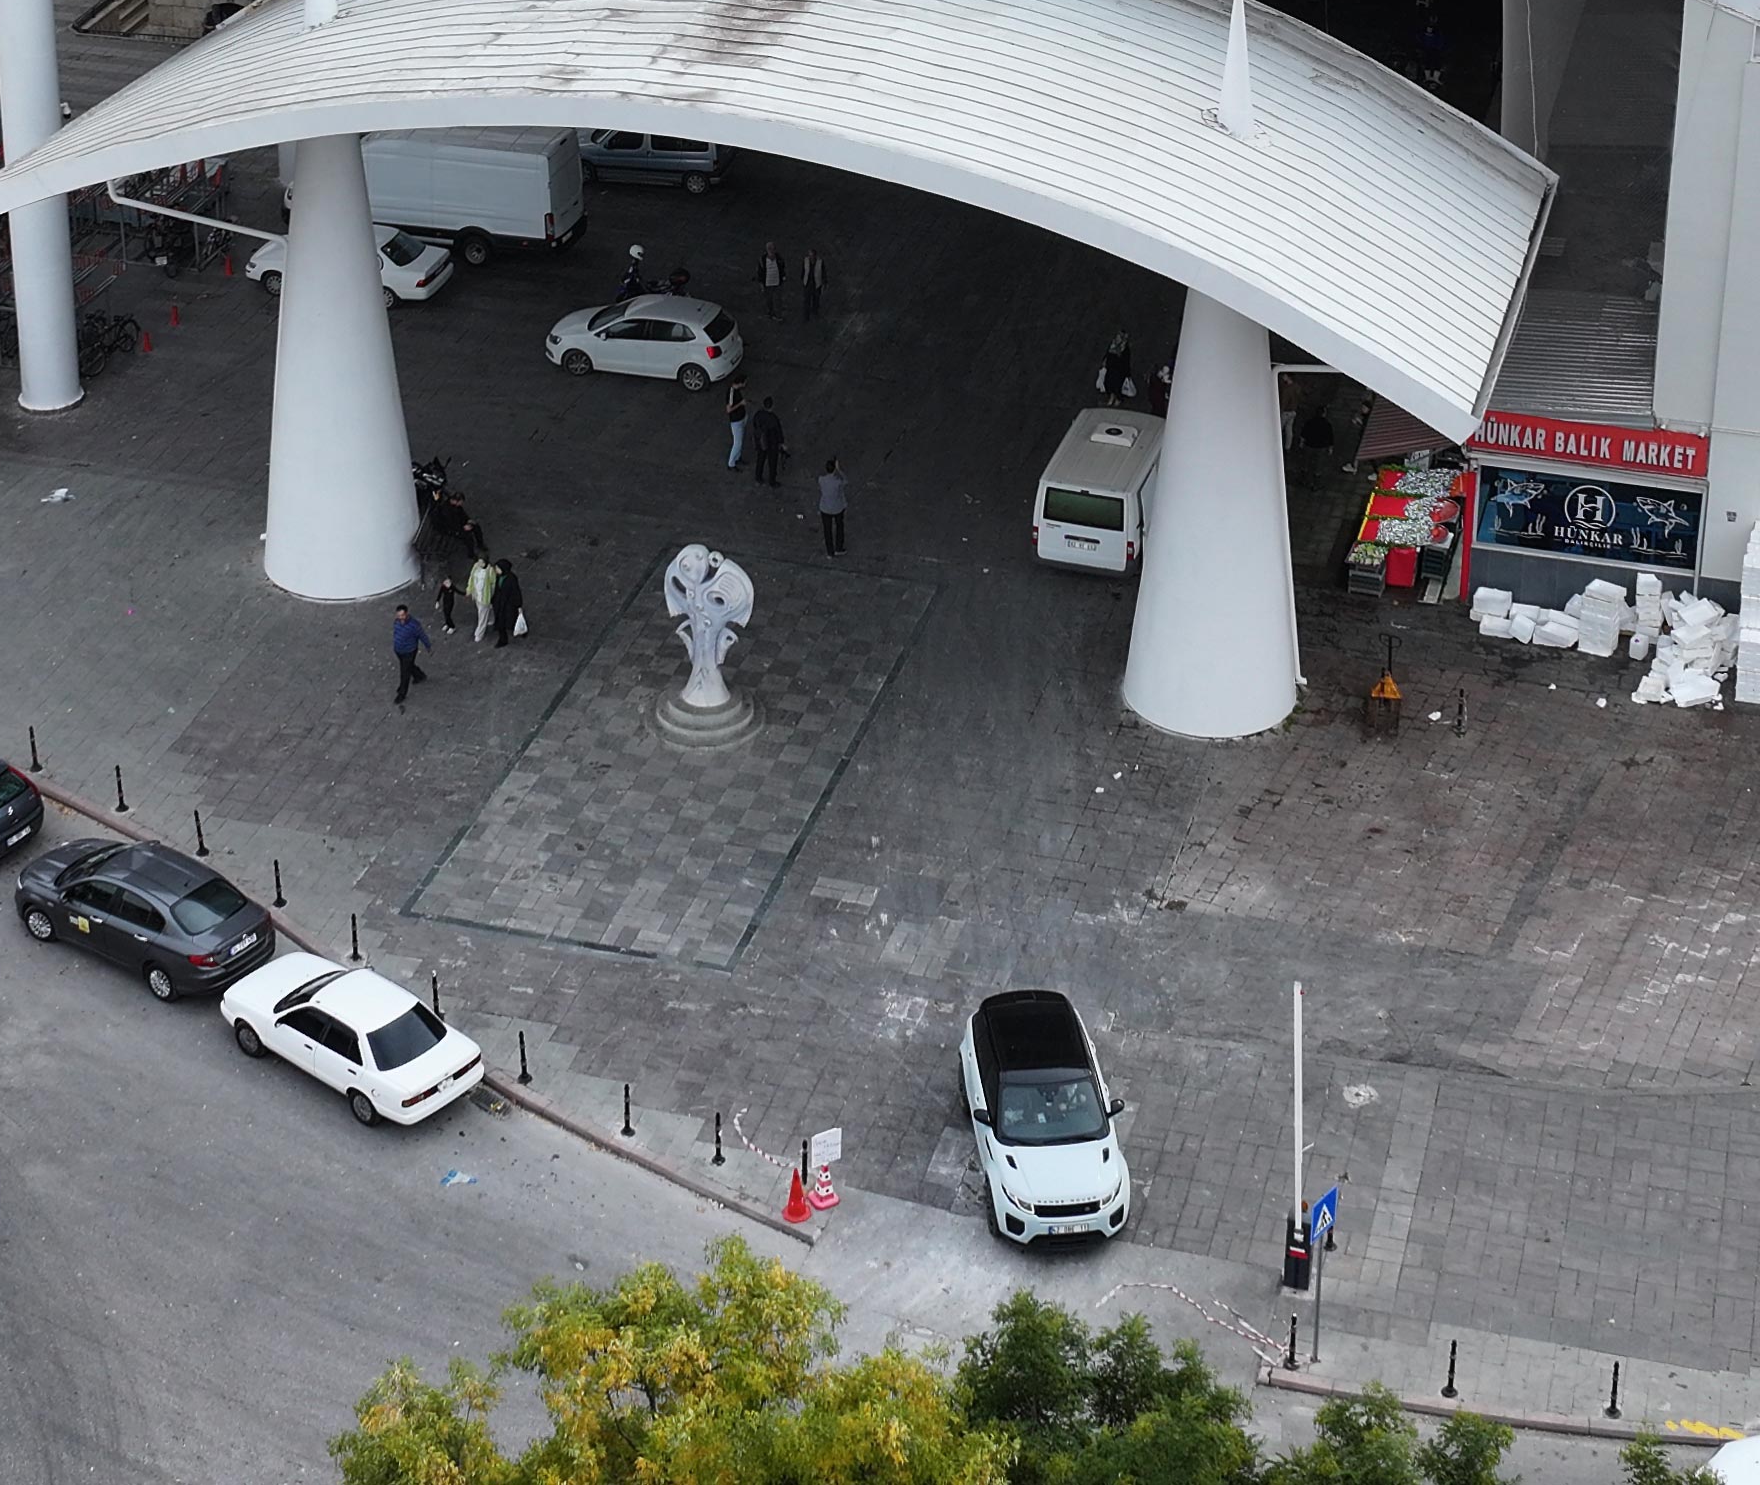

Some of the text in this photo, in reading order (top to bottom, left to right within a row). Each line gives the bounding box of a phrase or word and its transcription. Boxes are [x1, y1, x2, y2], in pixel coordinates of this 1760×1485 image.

[1474, 417, 1697, 470] HÜNKAR BALIK MARKET
[1554, 524, 1624, 545] HÜNKAR
